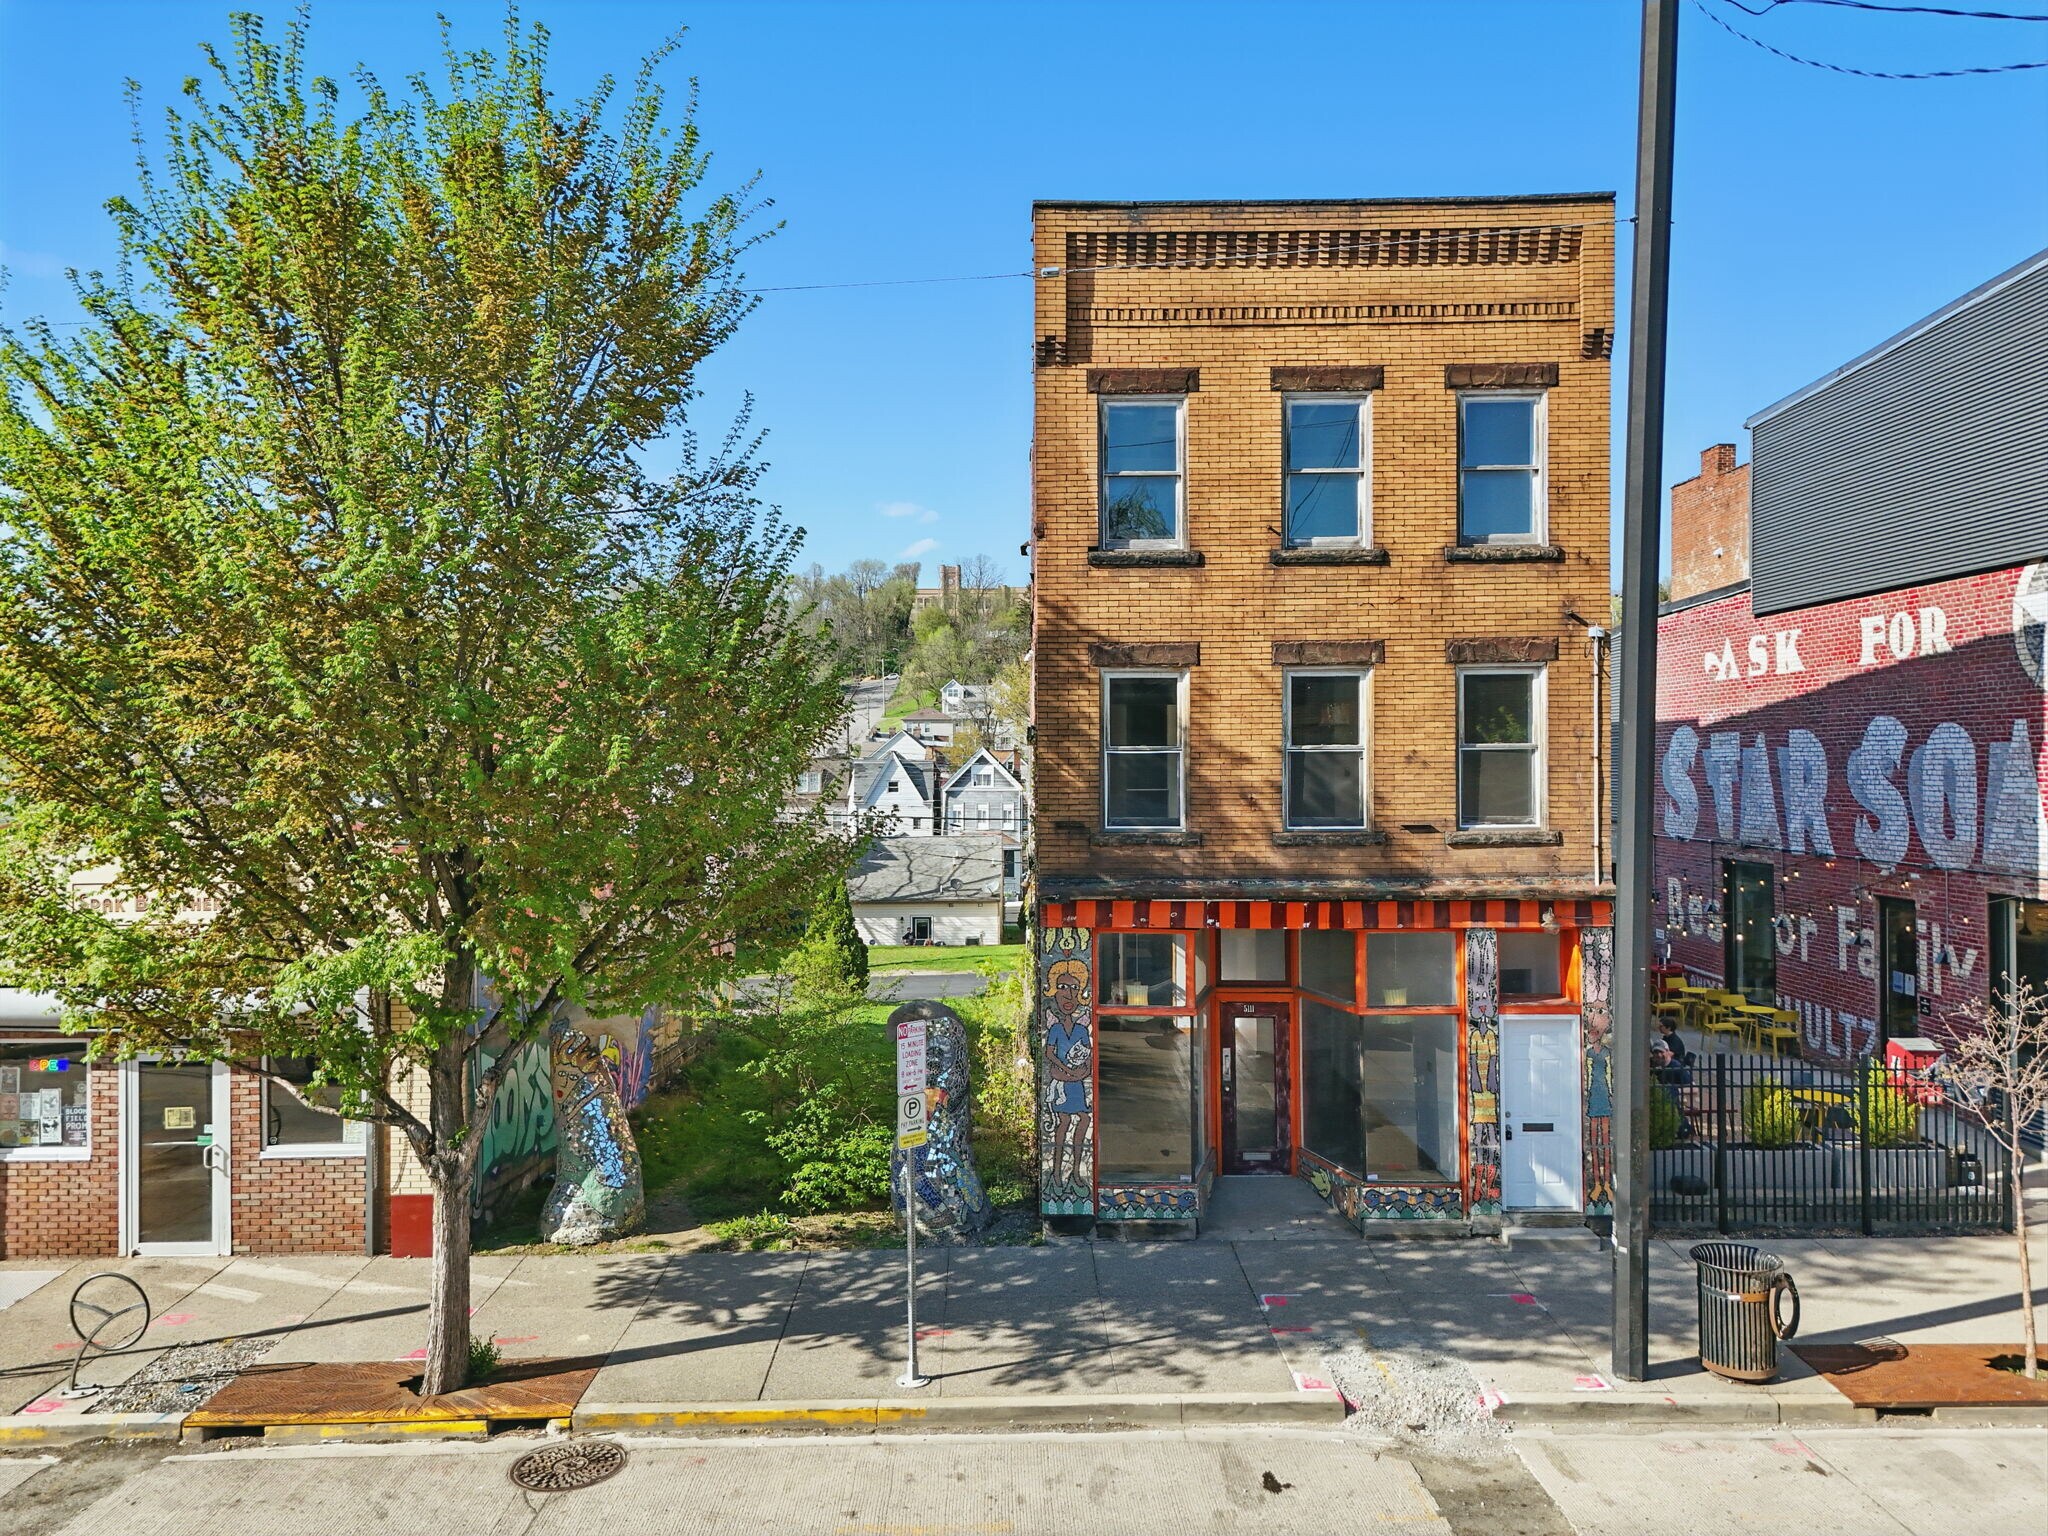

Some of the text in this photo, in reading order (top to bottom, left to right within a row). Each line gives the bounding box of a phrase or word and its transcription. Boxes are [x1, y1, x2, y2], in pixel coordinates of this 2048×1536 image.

[1704, 606, 1953, 681] ASK FOR
[1662, 724, 1836, 856] STAR
[899, 1025, 925, 1037] NO PARKING
[907, 1039, 924, 1048] MINUTE
[902, 1049, 921, 1059] LOADING
[905, 1059, 918, 1068] ZONE
[909, 1101, 918, 1115] P
